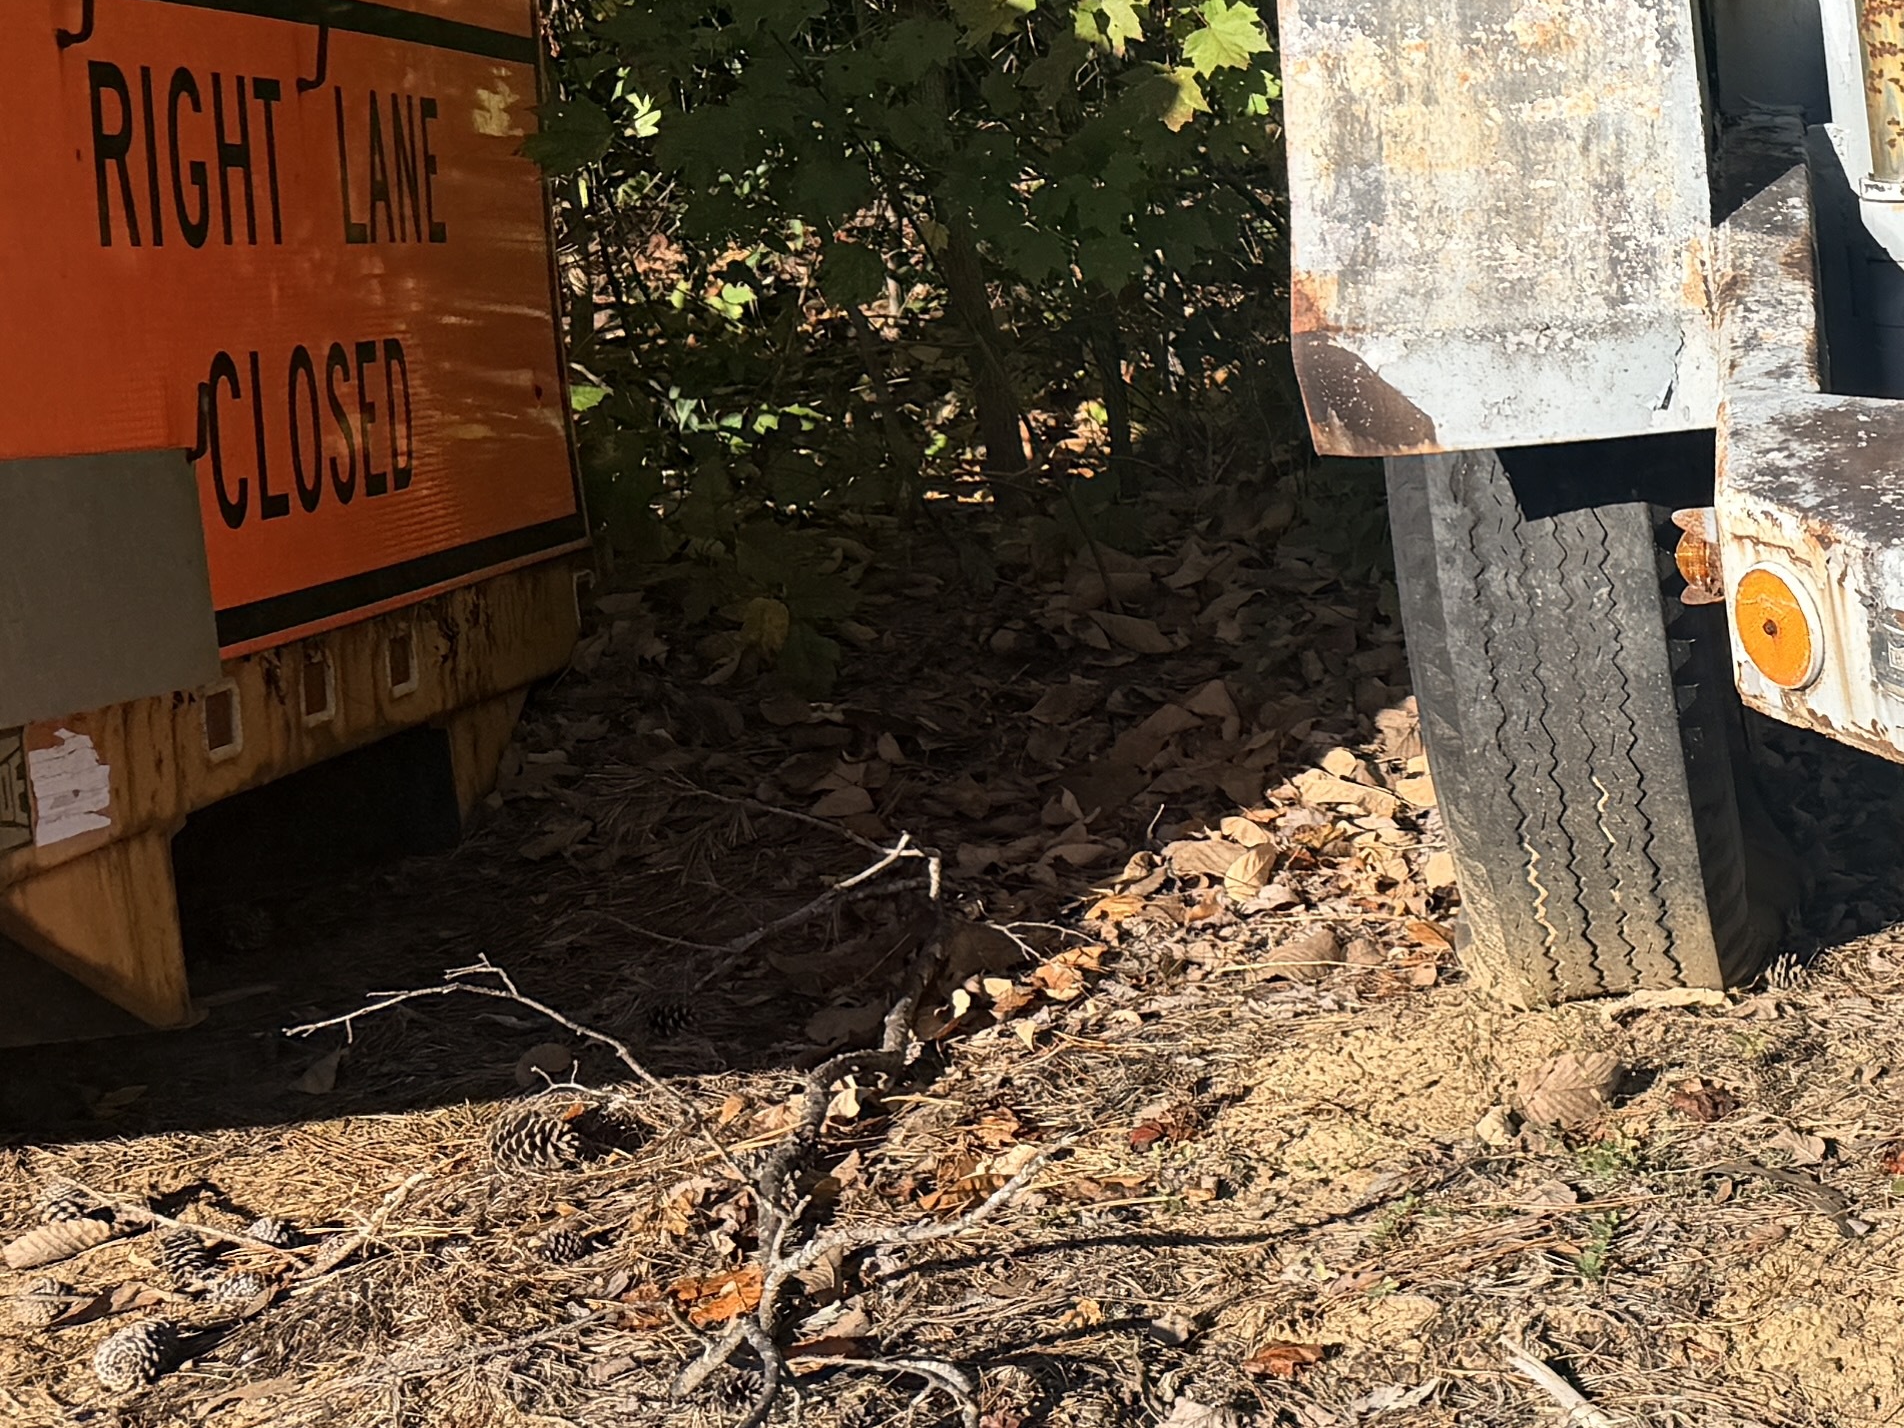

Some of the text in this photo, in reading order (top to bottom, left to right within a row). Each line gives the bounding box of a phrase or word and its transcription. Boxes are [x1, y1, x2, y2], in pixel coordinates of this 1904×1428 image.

[87, 59, 447, 249] RIGHT LANE
[208, 338, 413, 530] CLOSED
